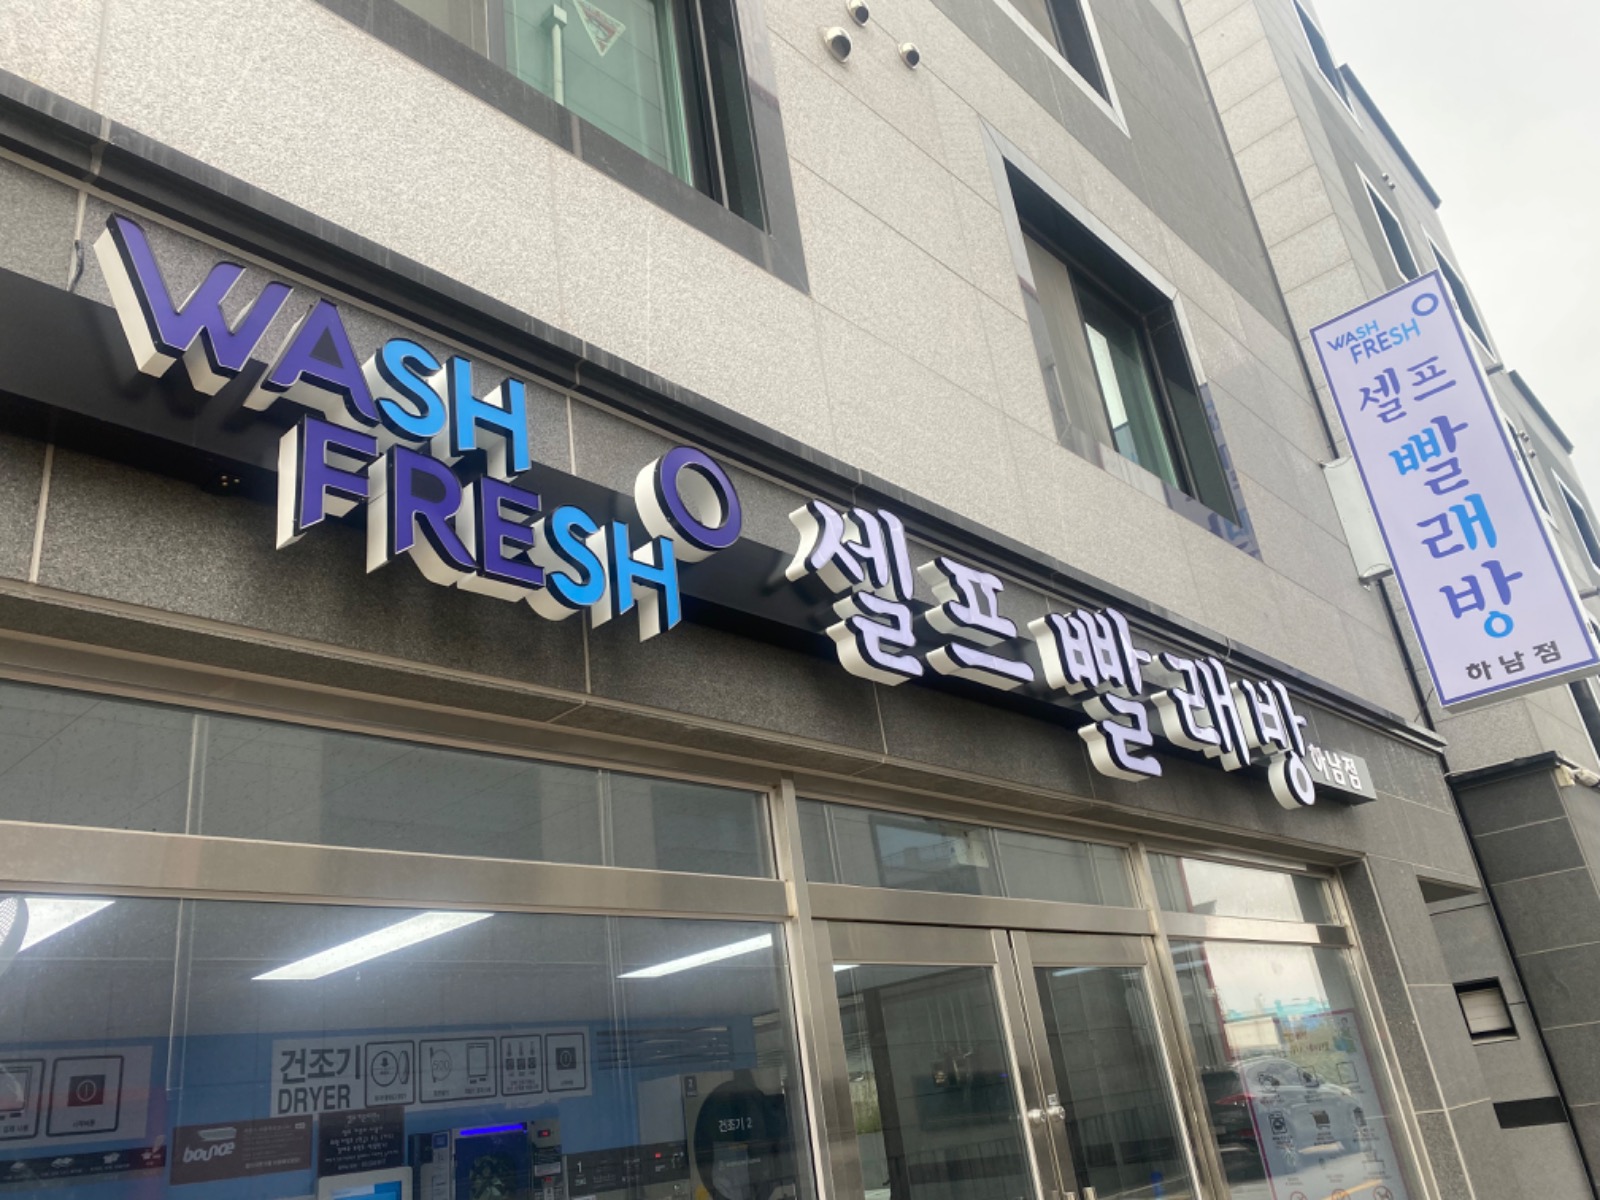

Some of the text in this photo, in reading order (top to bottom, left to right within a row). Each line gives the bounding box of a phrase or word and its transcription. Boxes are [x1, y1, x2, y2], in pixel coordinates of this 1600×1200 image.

[104, 212, 533, 475] WASH
[1327, 320, 1380, 351] WASH
[1349, 318, 1422, 365] FRESH
[1359, 356, 1457, 424] 셀프
[285, 413, 681, 635] FRESH
[795, 500, 1315, 807] 셀프 빨래방
[1465, 640, 1563, 681] 하남점
[279, 1044, 362, 1085] 건조기
[278, 1084, 352, 1115] DRYER
[718, 1117, 745, 1133] 건조기
[182, 1140, 237, 1164] bounce
